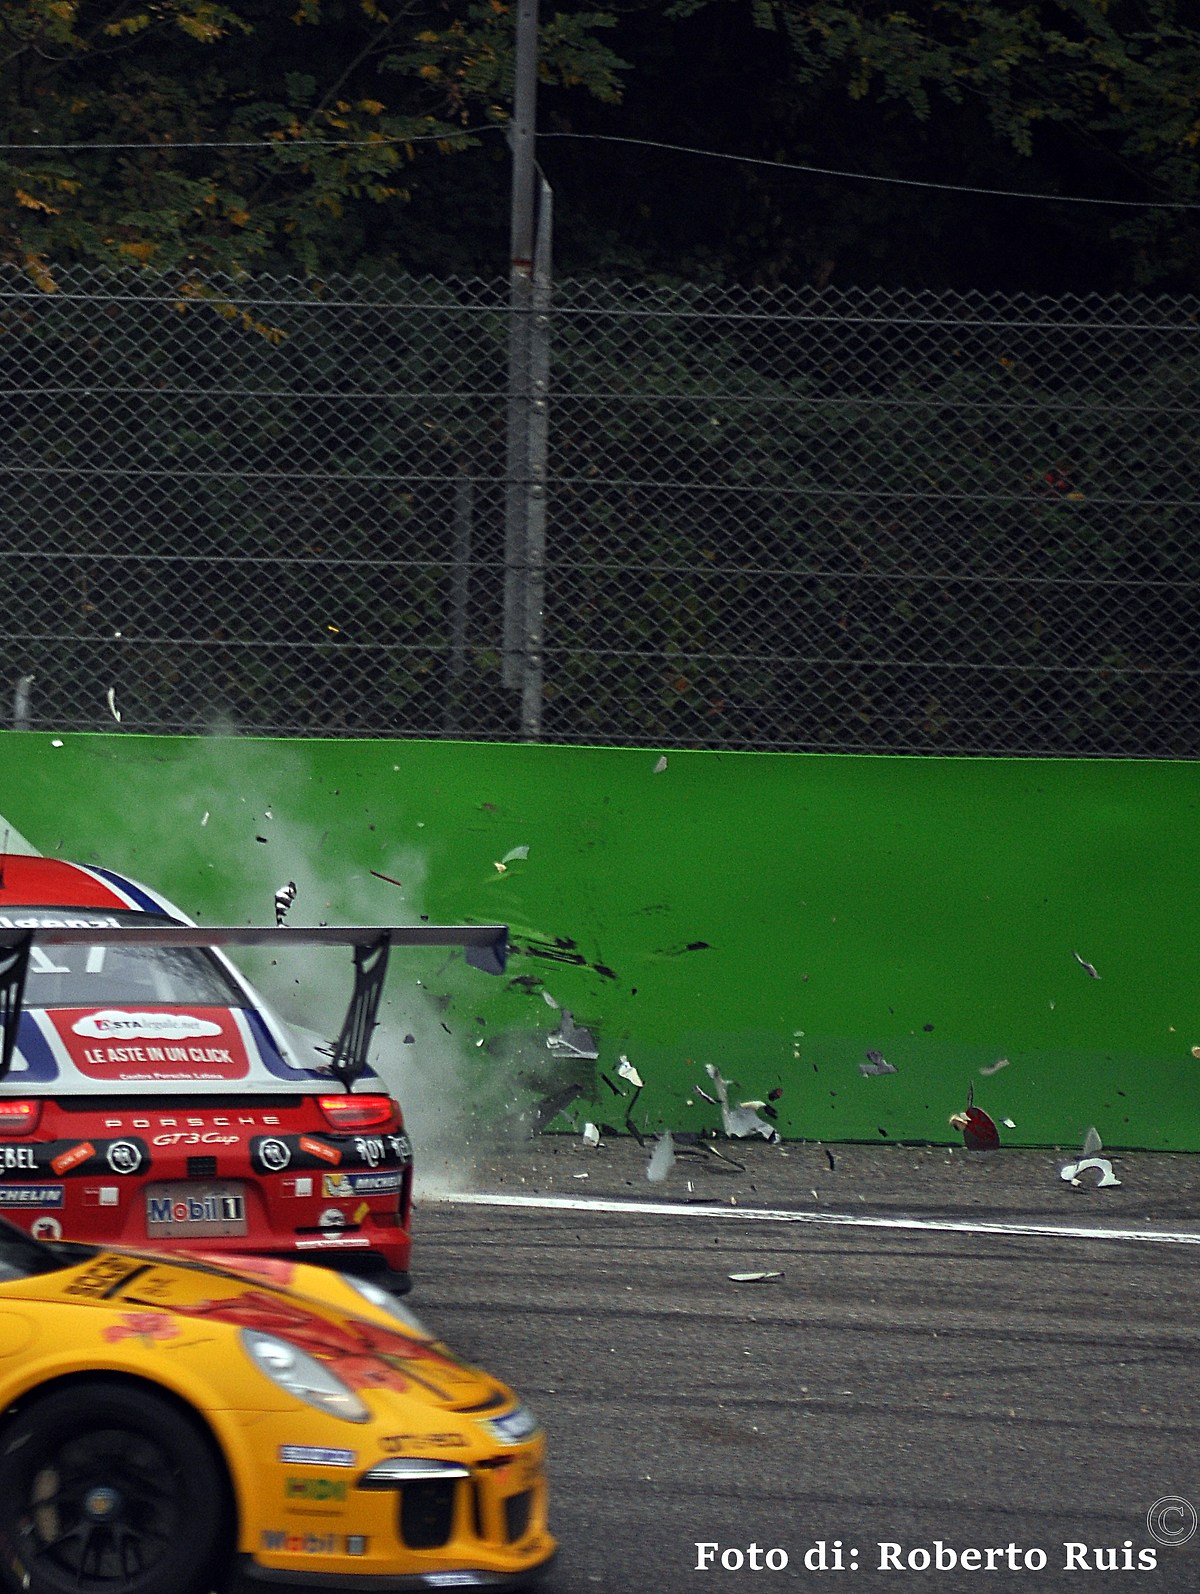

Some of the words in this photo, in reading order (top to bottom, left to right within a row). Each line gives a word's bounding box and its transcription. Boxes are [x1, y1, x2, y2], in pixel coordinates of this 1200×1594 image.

[84, 1049, 107, 1064] LE
[108, 1047, 144, 1063] ASTE
[145, 1047, 164, 1062] IN
[164, 1047, 188, 1062] UN
[192, 1048, 234, 1064] CLICK
[105, 1116, 280, 1128] PORSCHE
[354, 1137, 386, 1168] ROY
[149, 1197, 220, 1223] Mobil
[224, 1197, 242, 1220] 1
